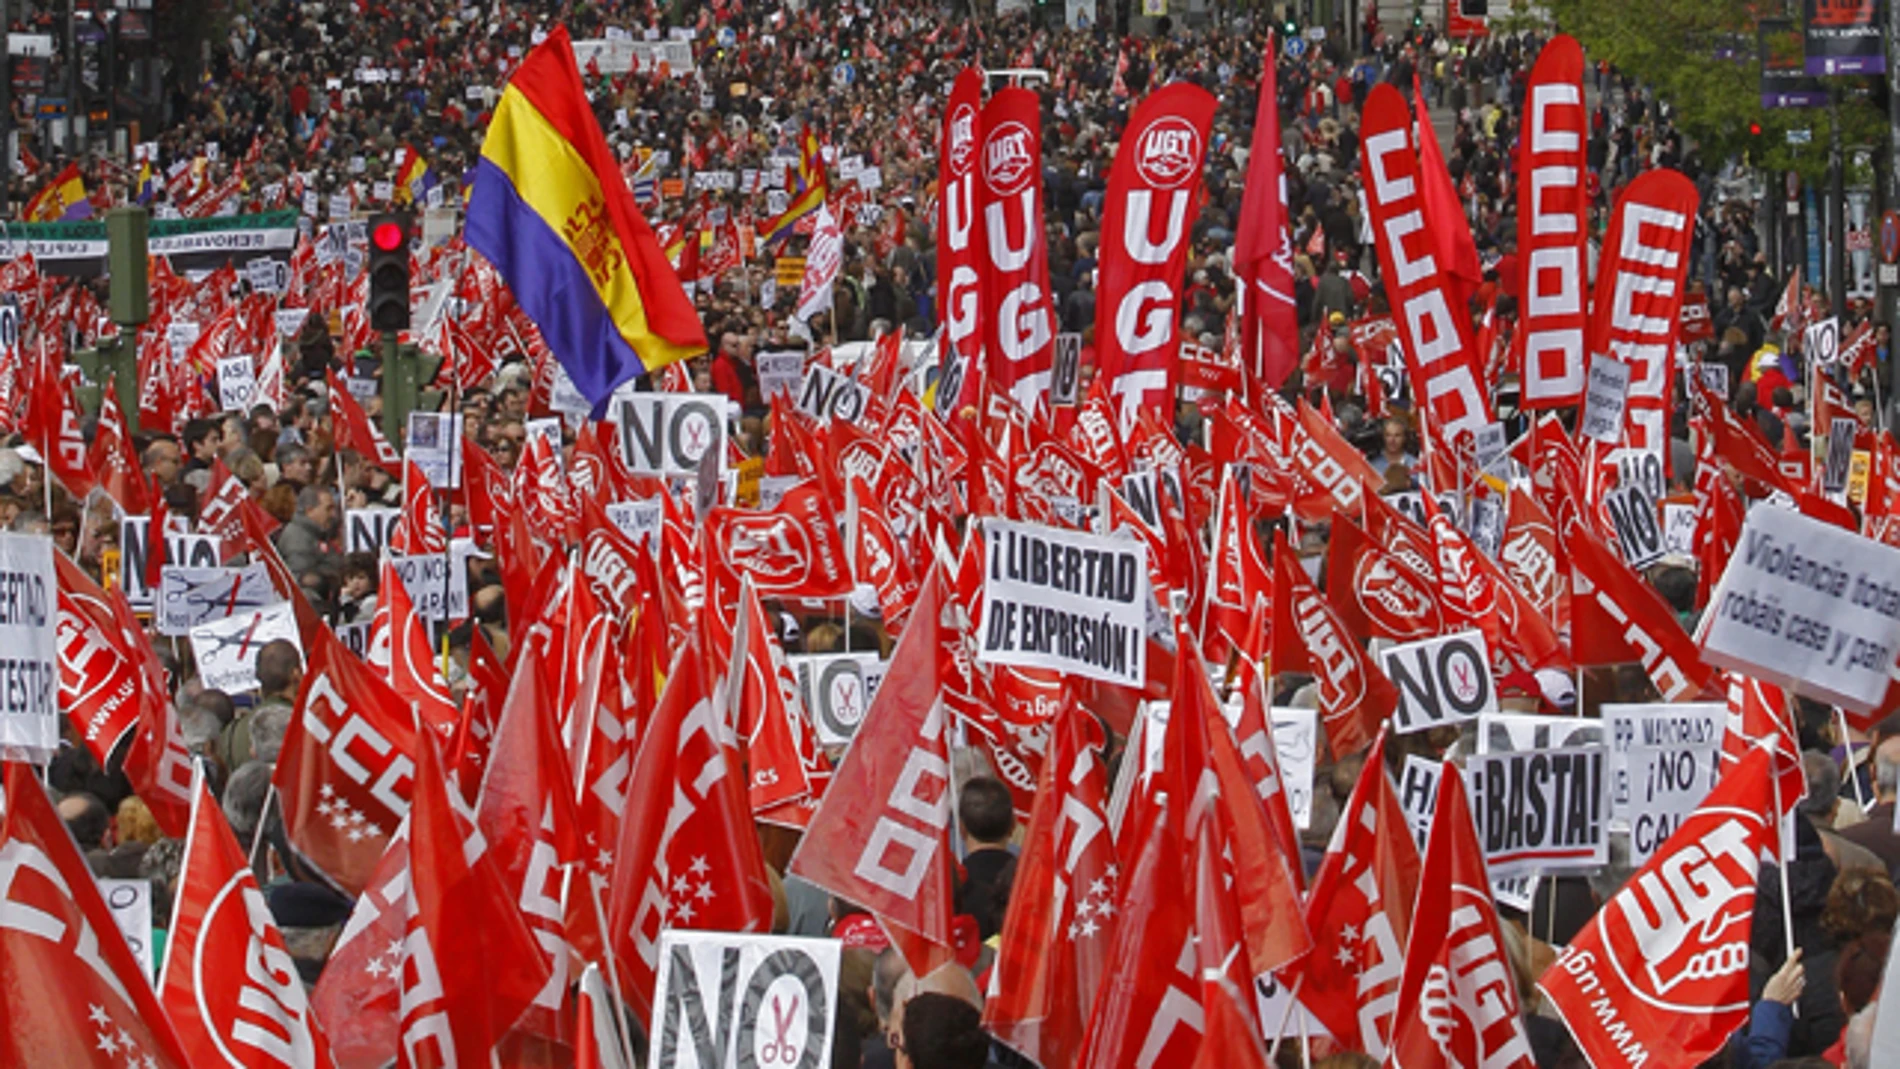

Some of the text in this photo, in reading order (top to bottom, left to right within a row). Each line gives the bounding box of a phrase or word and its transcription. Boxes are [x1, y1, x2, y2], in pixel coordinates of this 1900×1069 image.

[988, 132, 1027, 164] UGT
[1147, 129, 1192, 158] UGT
[1526, 84, 1584, 399] CCOO
[1109, 189, 1191, 445] UGT
[801, 367, 862, 421] NO
[622, 400, 721, 470] NO
[1608, 486, 1659, 561] NO
[1745, 529, 1850, 599] Violencia
[985, 599, 1016, 651] DE
[1386, 638, 1489, 727] NO
[1474, 752, 1601, 853] ¡BASTA!
[1617, 818, 1759, 964] UGT
[660, 943, 827, 1069] NO
